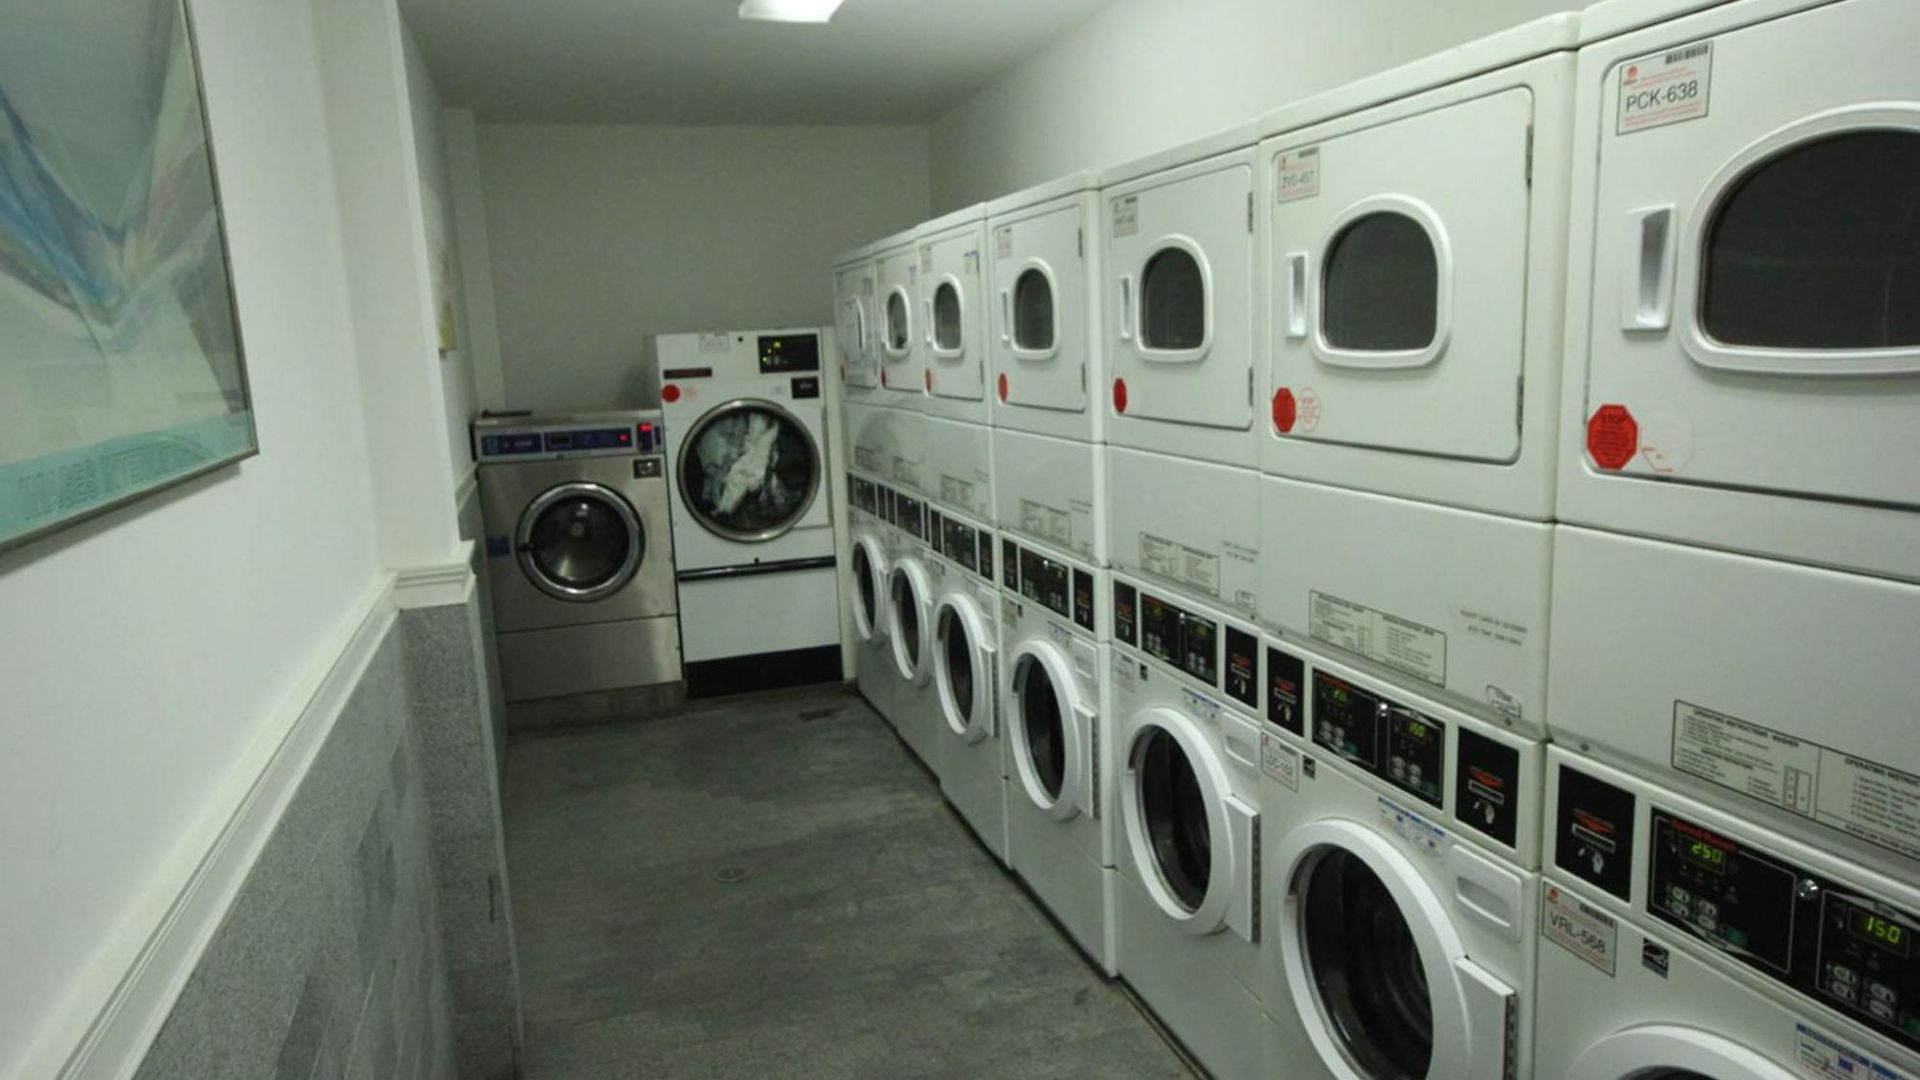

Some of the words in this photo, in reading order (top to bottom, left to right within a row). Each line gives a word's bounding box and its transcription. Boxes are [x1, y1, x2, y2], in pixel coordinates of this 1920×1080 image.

[1626, 80, 1698, 112] PCK-638
[1844, 757, 1886, 776] OPERATING
[1691, 841, 1722, 864] 250
[1550, 911, 1606, 954] VRL-568
[1867, 916, 1901, 944] 150
